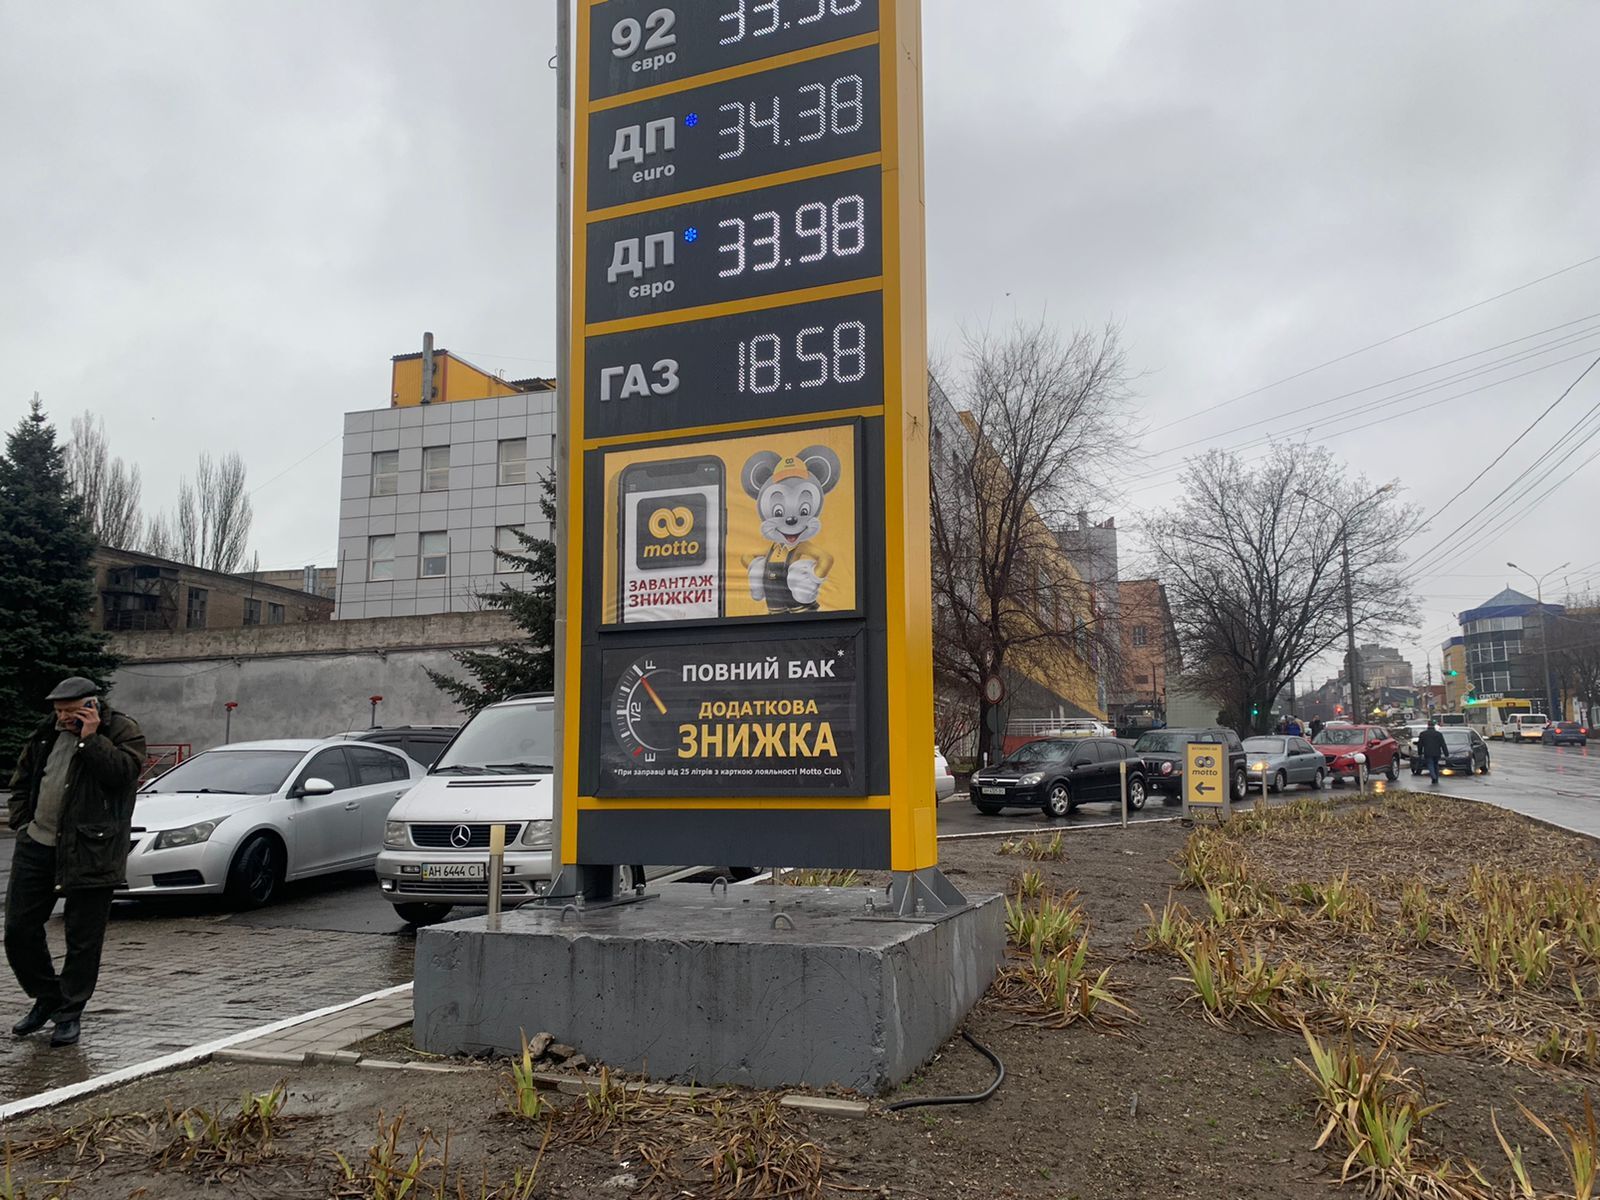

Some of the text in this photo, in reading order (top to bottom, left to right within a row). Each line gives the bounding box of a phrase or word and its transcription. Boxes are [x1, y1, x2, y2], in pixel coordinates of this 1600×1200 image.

[611, 8, 677, 58] 92
[719, 0, 862, 45] 33.
[631, 50, 677, 73] євро
[718, 73, 864, 161] 34.38
[608, 116, 677, 170] ДП
[632, 164, 675, 184] euro
[718, 194, 865, 278] 33.98
[607, 231, 675, 283] ДП
[628, 279, 675, 299] євро
[737, 320, 866, 394] 18.58
[599, 358, 680, 402] ГАЗ
[643, 540, 700, 558] motto
[629, 575, 713, 592] ЗАВАНТАЖ
[629, 589, 712, 607] ЗНИЖКИ!
[645, 660, 656, 670] F
[682, 656, 779, 682] ПОВНИЙ
[630, 702, 642, 723] 1/2
[698, 700, 818, 720] ДОДАТКОВА
[677, 722, 838, 759] ЗНИЖКА
[645, 752, 656, 762] E
[633, 769, 666, 777] заправці
[667, 768, 679, 777] від
[680, 768, 690, 776] 25
[691, 768, 713, 777] літрів
[720, 769, 753, 777] карткою
[755, 767, 797, 776] лояльності
[799, 768, 822, 776] Motto
[823, 767, 842, 776] Club
[443, 865, 465, 876] 6444
